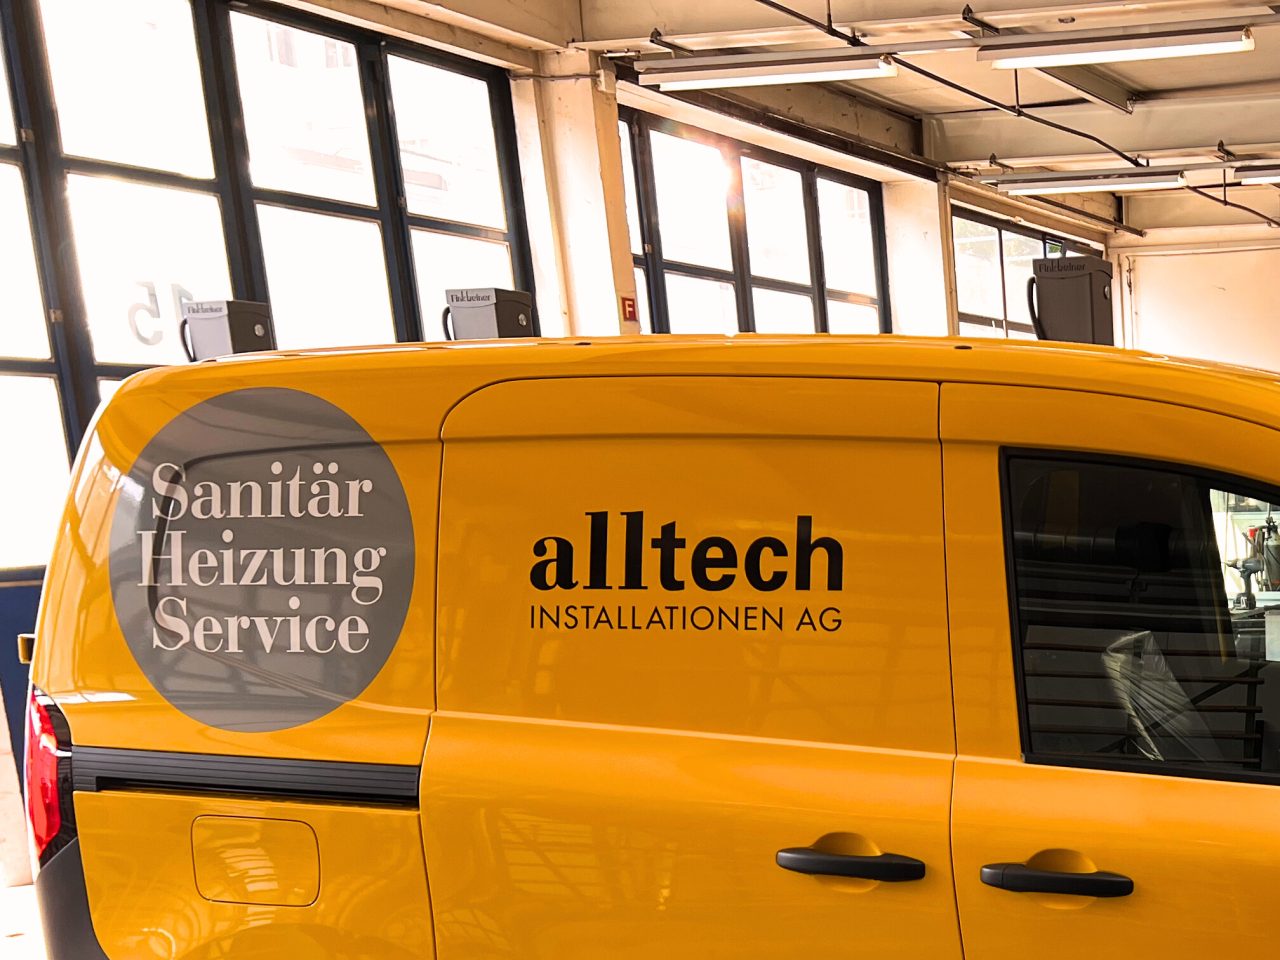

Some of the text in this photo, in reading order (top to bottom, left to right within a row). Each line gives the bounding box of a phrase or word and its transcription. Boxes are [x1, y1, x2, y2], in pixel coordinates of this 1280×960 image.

[625, 300, 634, 318] F
[152, 461, 373, 521] Sanitär
[137, 529, 387, 605] Heizung
[529, 510, 844, 592] alltech
[152, 596, 370, 654] Service
[530, 605, 843, 632] INSTALLATIONEN AG
